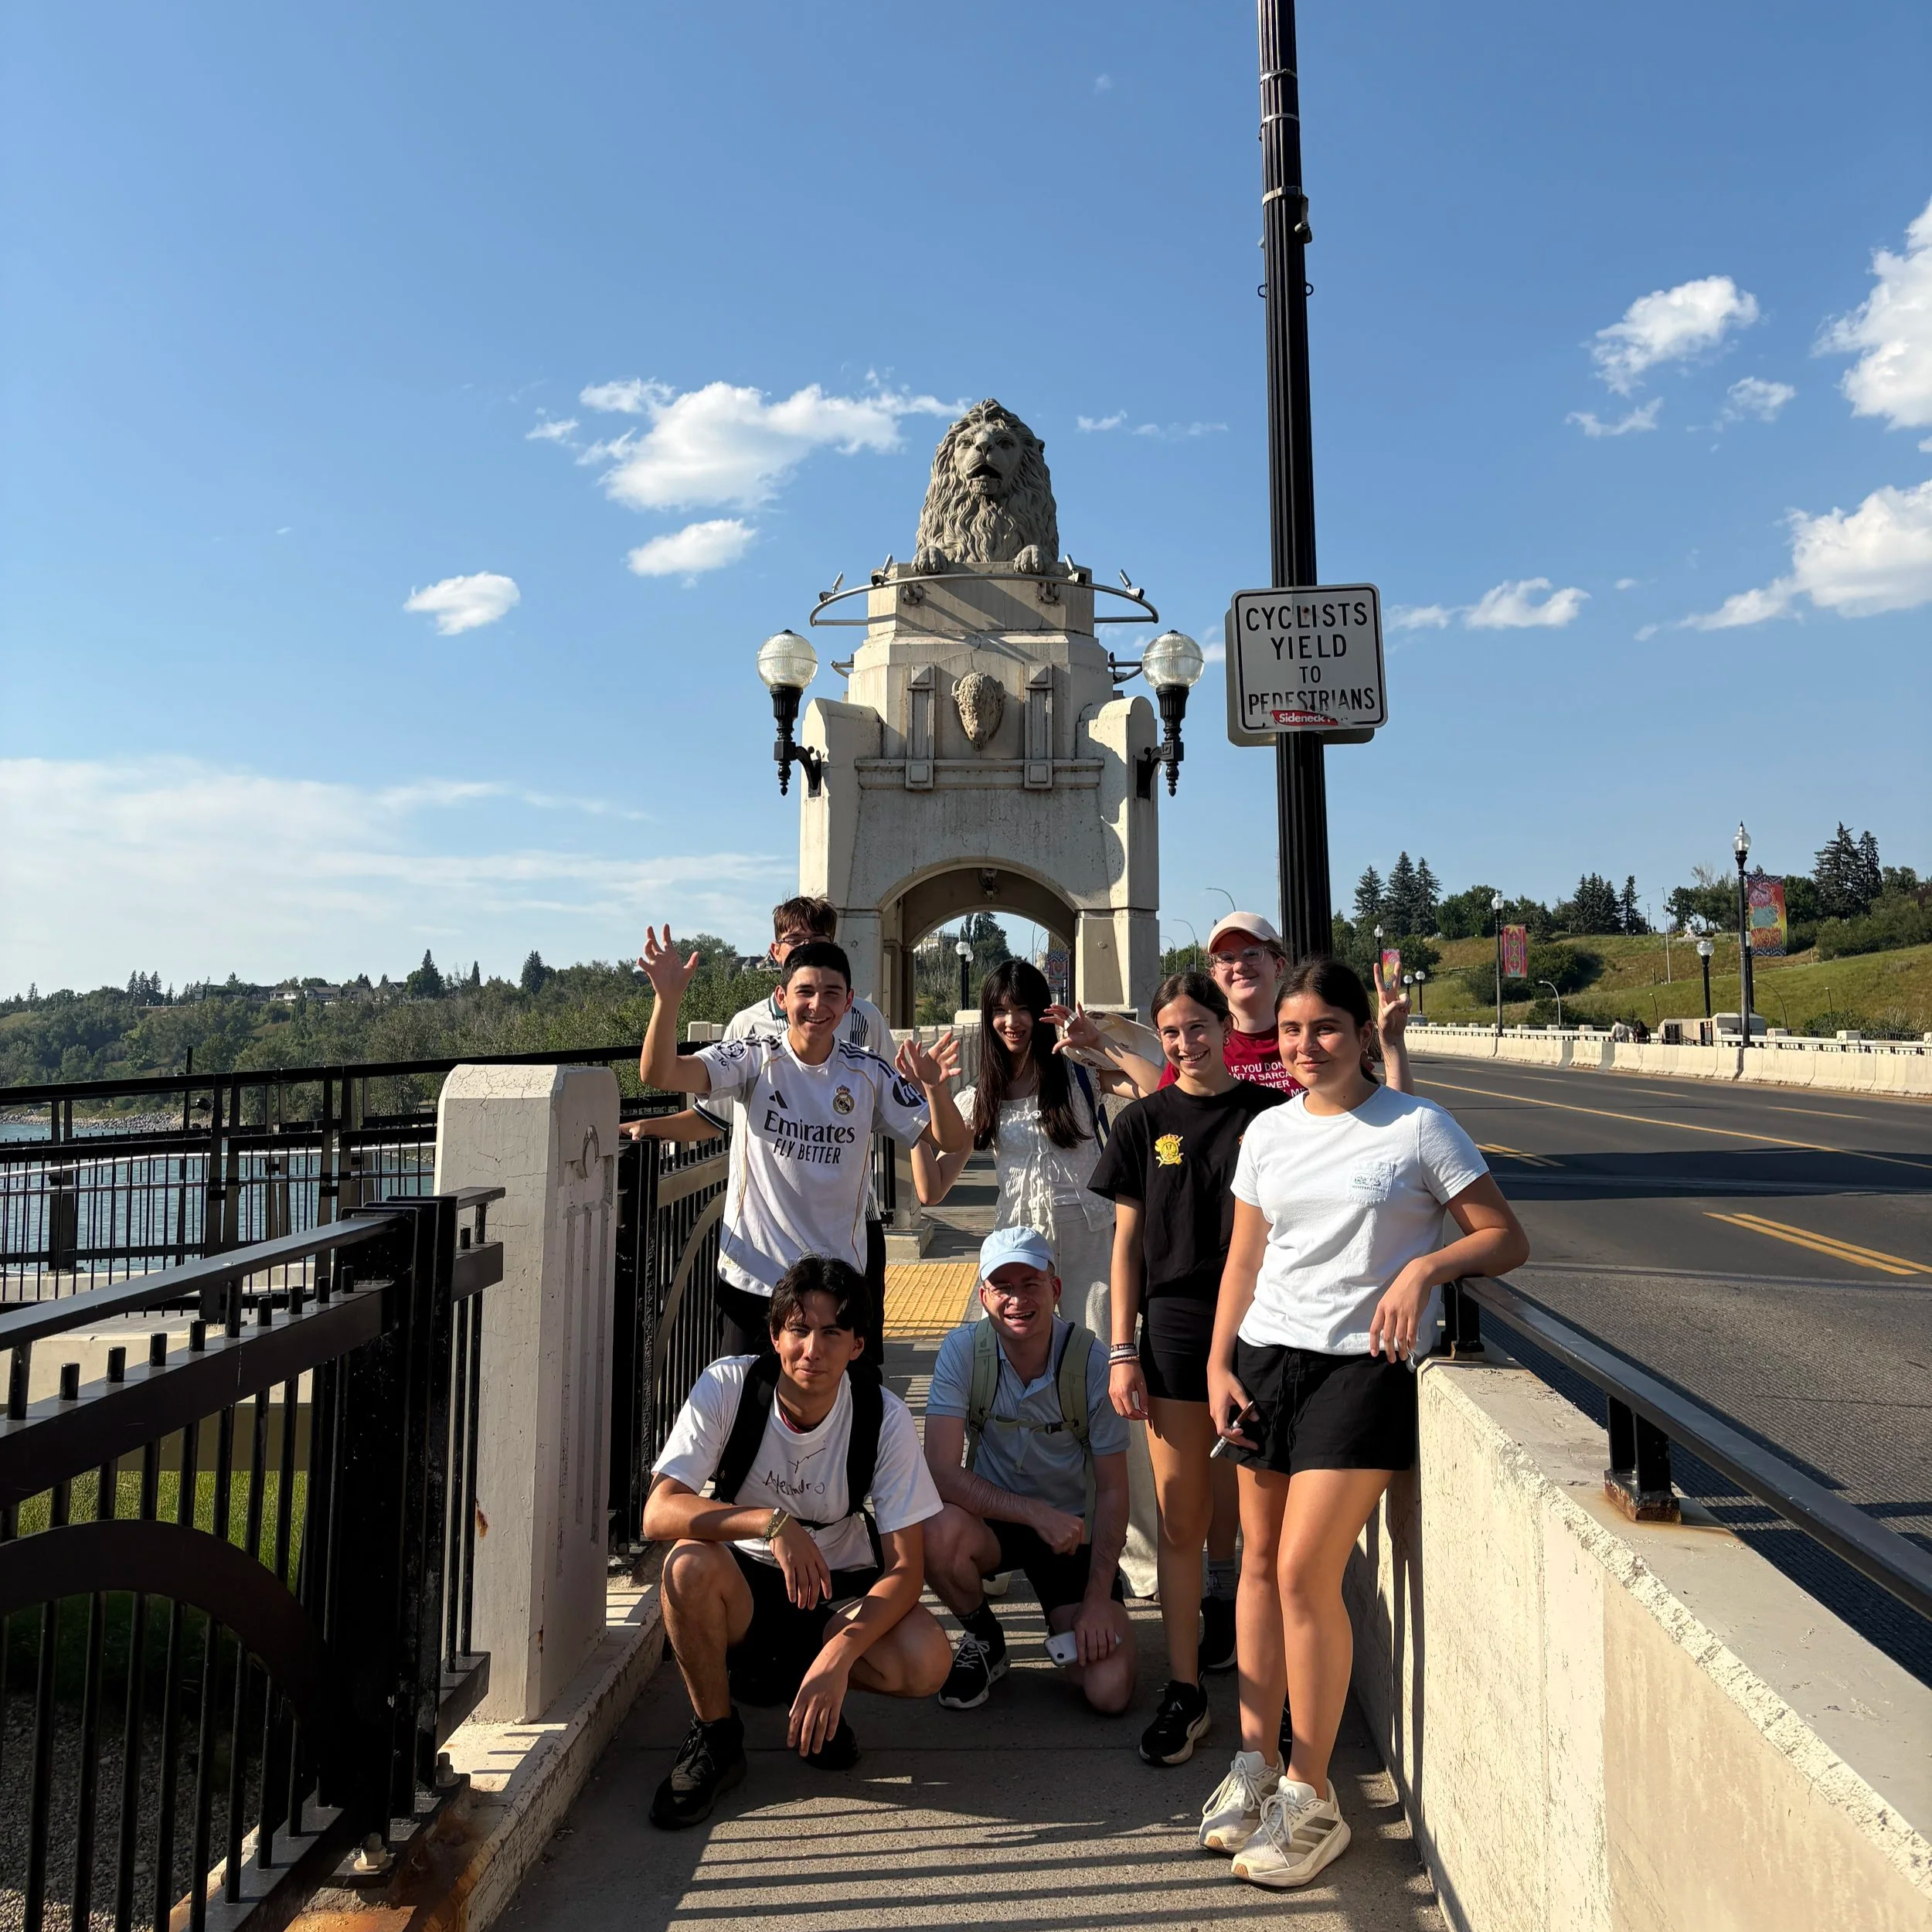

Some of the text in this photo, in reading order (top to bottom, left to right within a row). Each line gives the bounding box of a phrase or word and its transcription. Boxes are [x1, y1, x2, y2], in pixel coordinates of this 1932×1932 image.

[1246, 602, 1368, 631] CYCLISTS
[1270, 634, 1347, 660] YIELD
[1299, 665, 1321, 684] TO
[1242, 1063, 1262, 1073] YOU
[1264, 1061, 1285, 1071] DON
[1258, 1071, 1292, 1081] SARCA
[764, 1109, 855, 1144] Emirates
[774, 1138, 841, 1165] FLY BETTER
